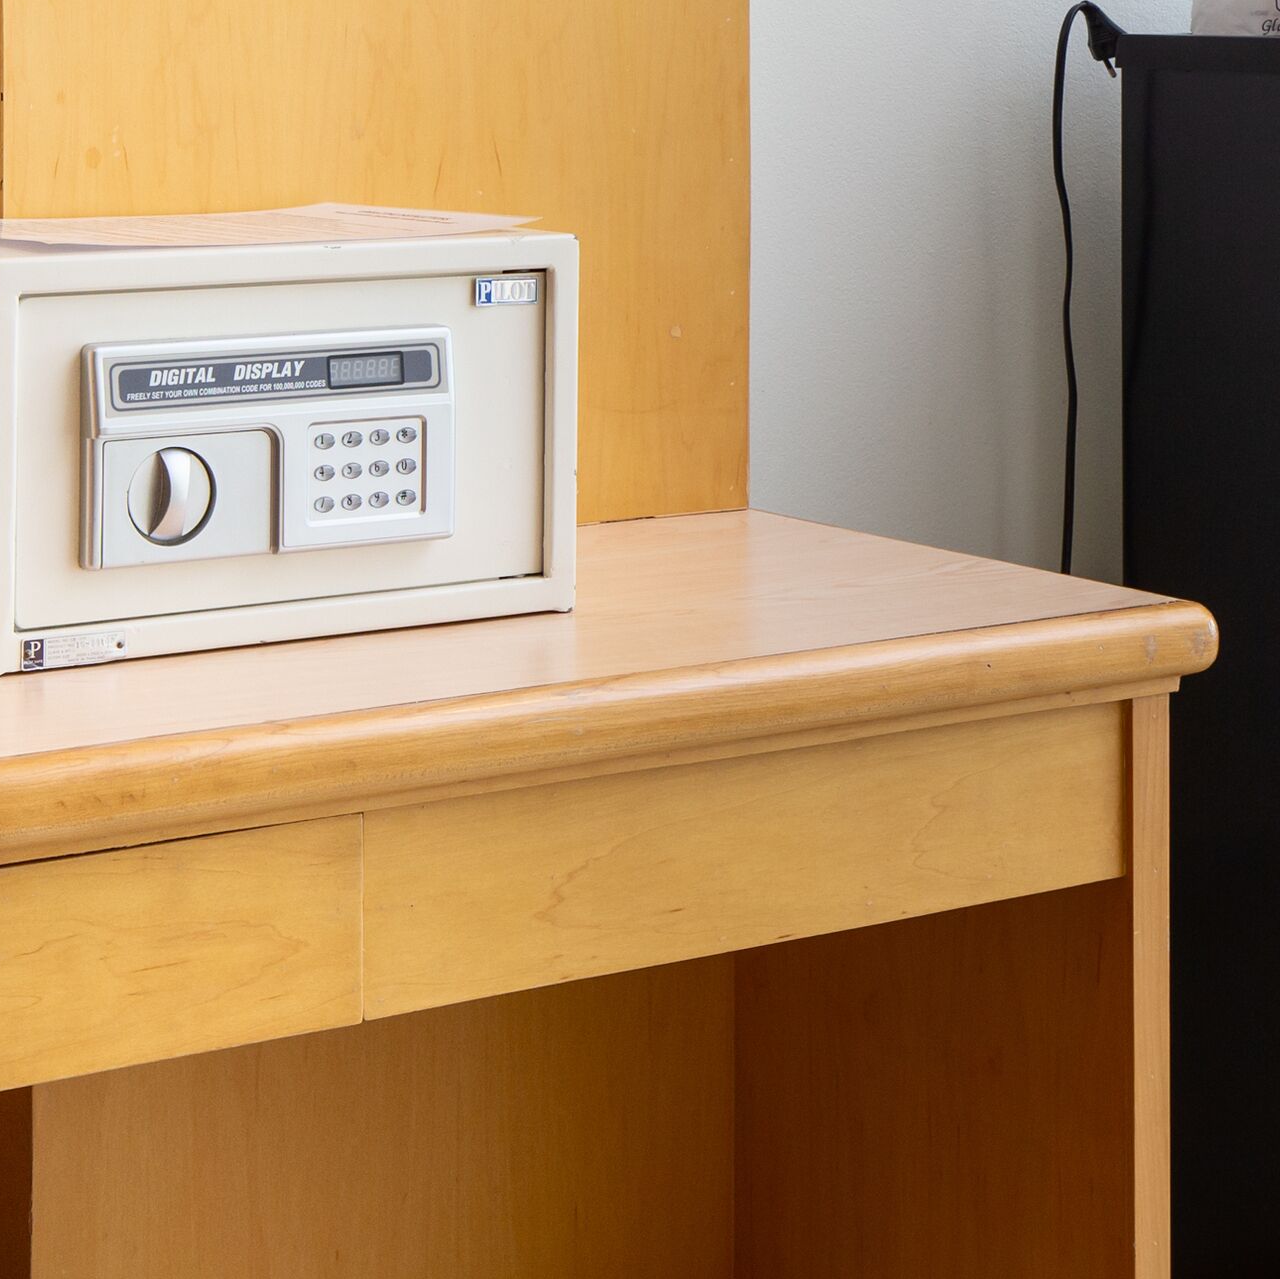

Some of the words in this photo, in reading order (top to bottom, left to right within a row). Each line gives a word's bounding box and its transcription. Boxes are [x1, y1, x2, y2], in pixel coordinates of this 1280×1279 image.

[479, 281, 536, 302] PILOT
[149, 367, 216, 387] DIGITAL
[233, 360, 305, 381] DISPLAY
[127, 393, 151, 401] FREELY
[151, 391, 164, 400] SET
[164, 390, 182, 399] YOUR
[183, 388, 198, 397] OWN
[198, 386, 241, 397] COMBINATION
[241, 384, 259, 393] CODE
[259, 383, 272, 392] FOR
[305, 379, 326, 389] CODES
